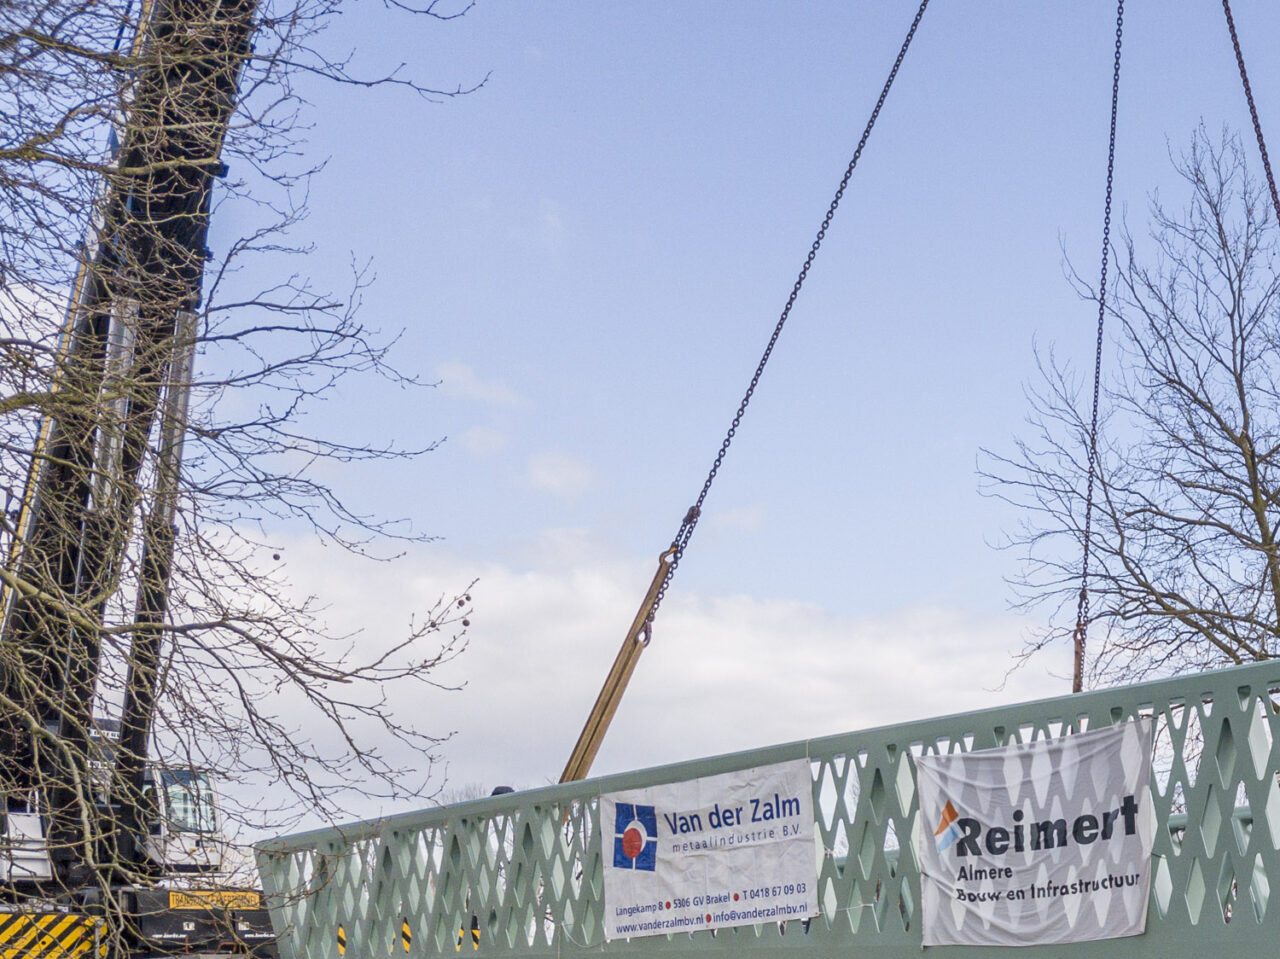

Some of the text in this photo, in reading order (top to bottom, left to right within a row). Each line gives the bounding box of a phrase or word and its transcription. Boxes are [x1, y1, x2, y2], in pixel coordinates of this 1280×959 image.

[664, 793, 800, 835] Van der Zalm
[956, 795, 1139, 857] Reimert
[672, 823, 802, 853] metaalindustrie B.V.
[956, 873, 1141, 903] Bouw en Infrastructuur
[957, 864, 1013, 882] Almere
[615, 883, 806, 917] Langekamp 8 5306 GV Brakel T 0418 67 09 03
[615, 902, 808, 934] www.vanderzalmbv.nl info@vanderzalmbv.nl
